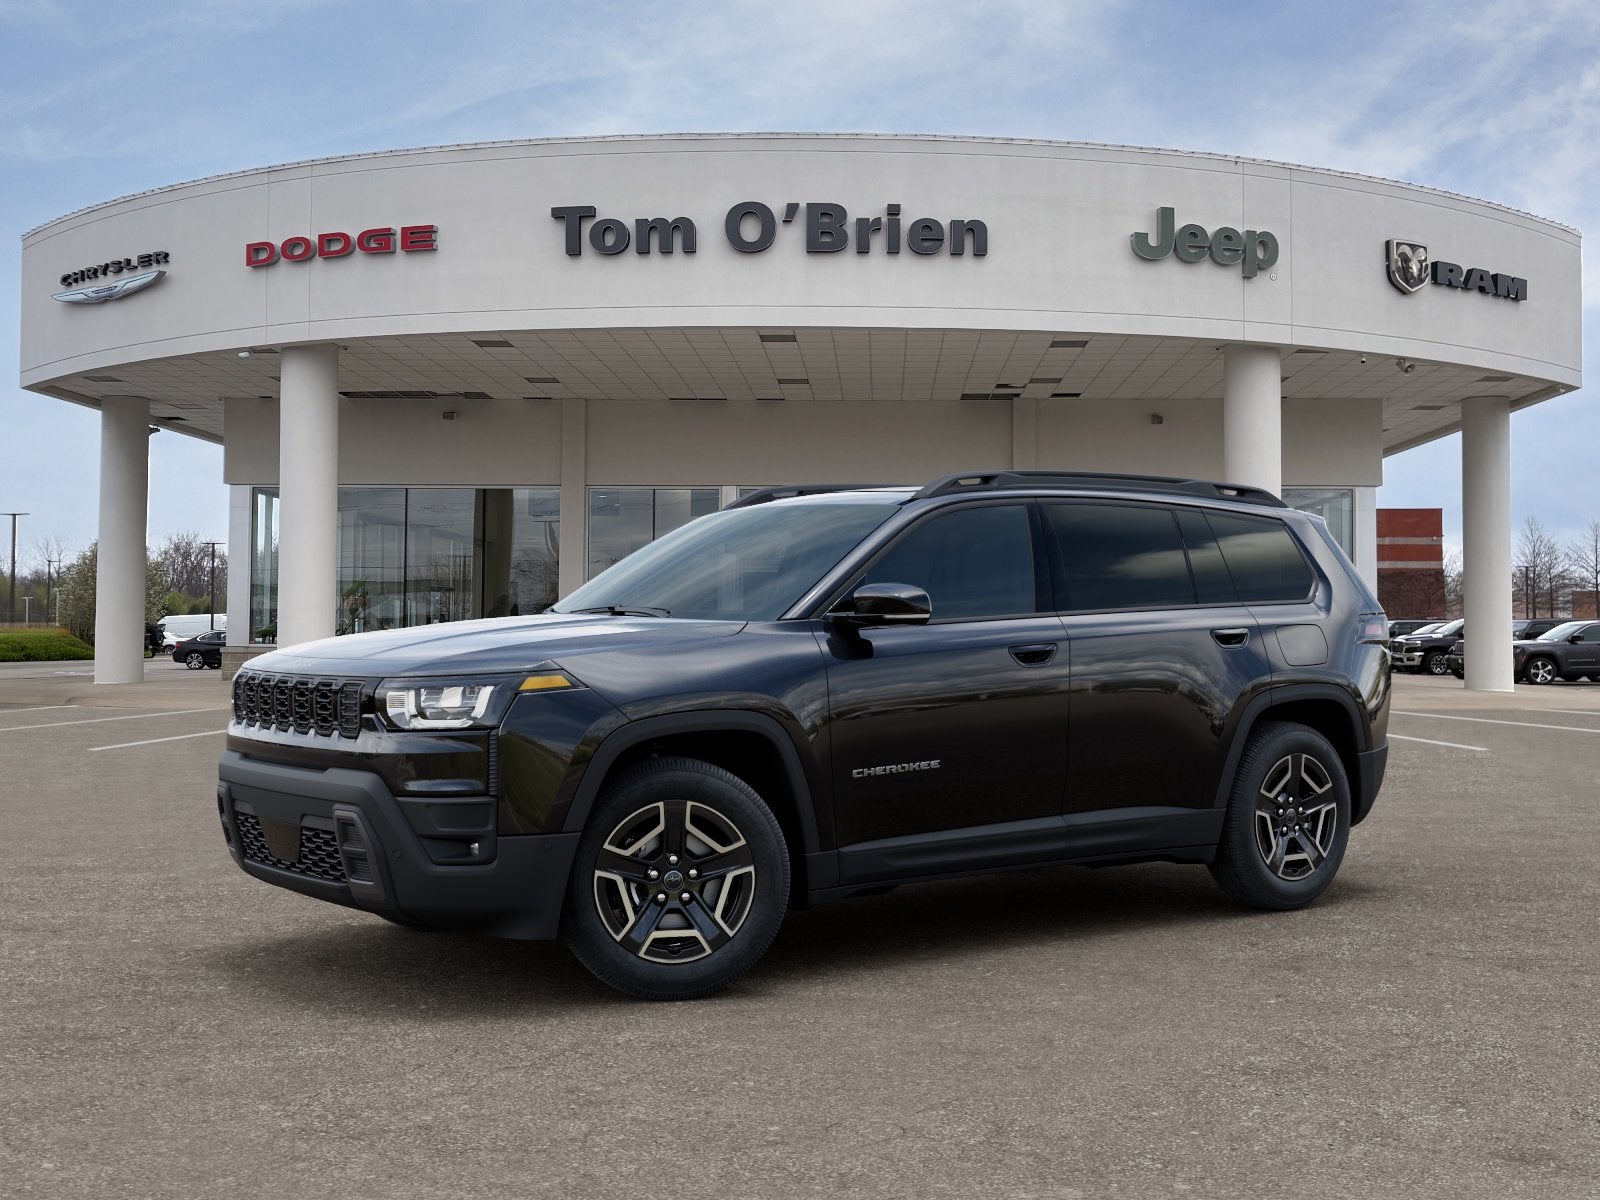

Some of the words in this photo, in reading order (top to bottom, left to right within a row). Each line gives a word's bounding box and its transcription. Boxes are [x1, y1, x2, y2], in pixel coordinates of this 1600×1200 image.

[245, 224, 438, 268] DODGE
[551, 205, 697, 256] Tom
[725, 201, 989, 256] O'Brien
[1131, 206, 1279, 278] Jeep
[60, 250, 170, 287] CHRYSLER
[1430, 260, 1528, 301] RAM
[852, 759, 941, 778] CHEROKEE
